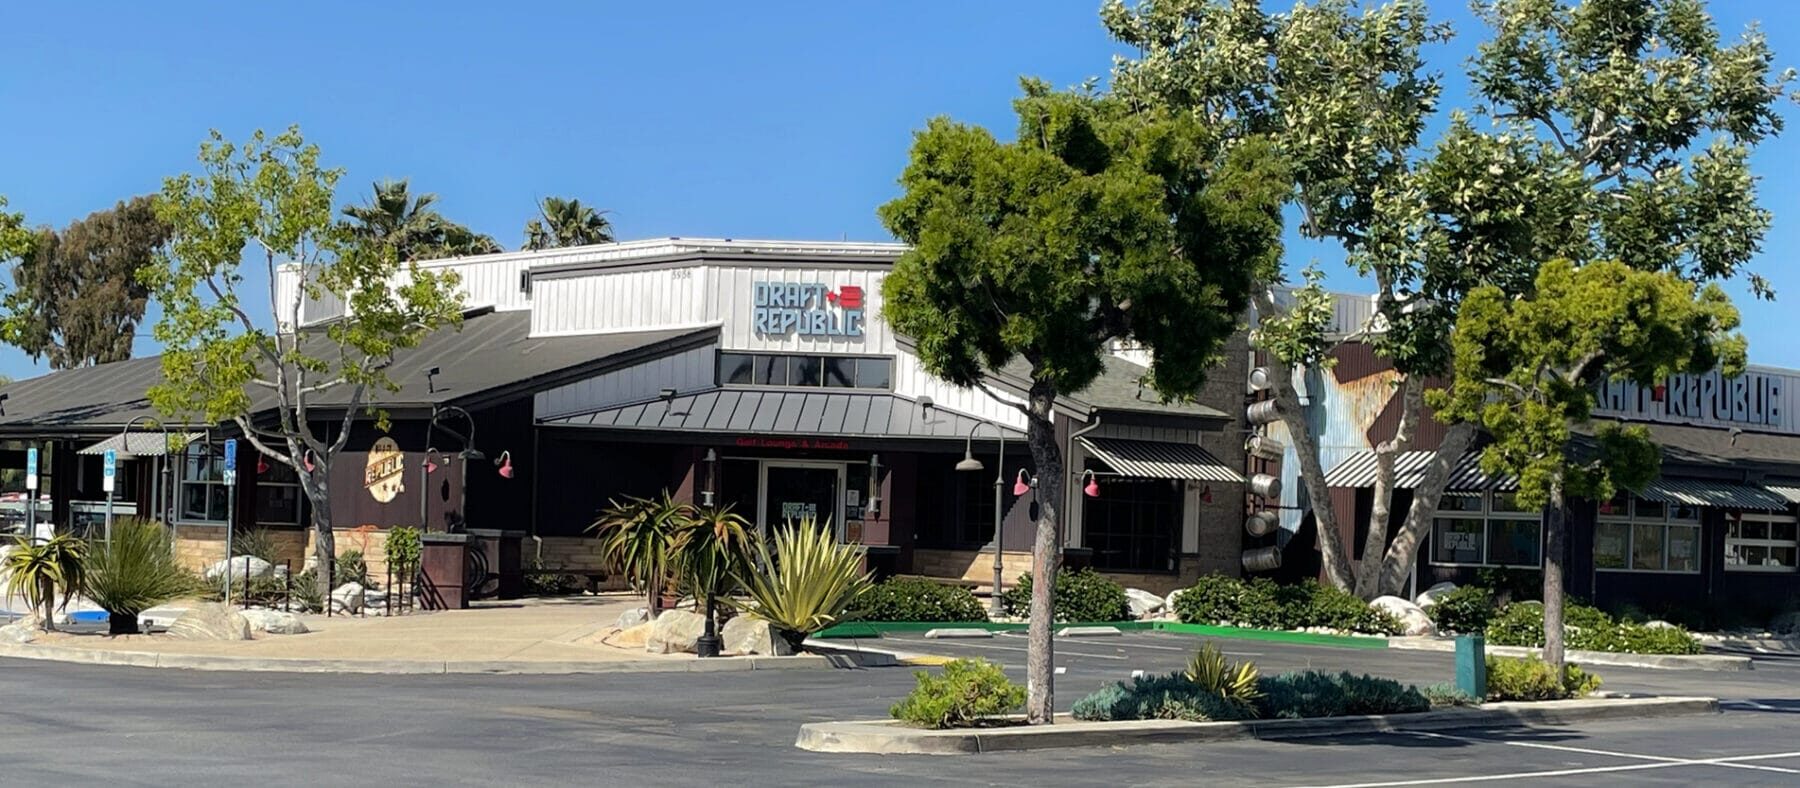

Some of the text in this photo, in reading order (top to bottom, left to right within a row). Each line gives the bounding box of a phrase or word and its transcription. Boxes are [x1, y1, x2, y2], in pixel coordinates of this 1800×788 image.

[754, 282, 826, 307] DRAFT
[753, 308, 864, 336] REPUBLIC
[1669, 372, 1782, 424] REPUBLIC
[761, 438, 797, 449] Lounge
[801, 439, 809, 448] &
[814, 440, 848, 449] Arcade
